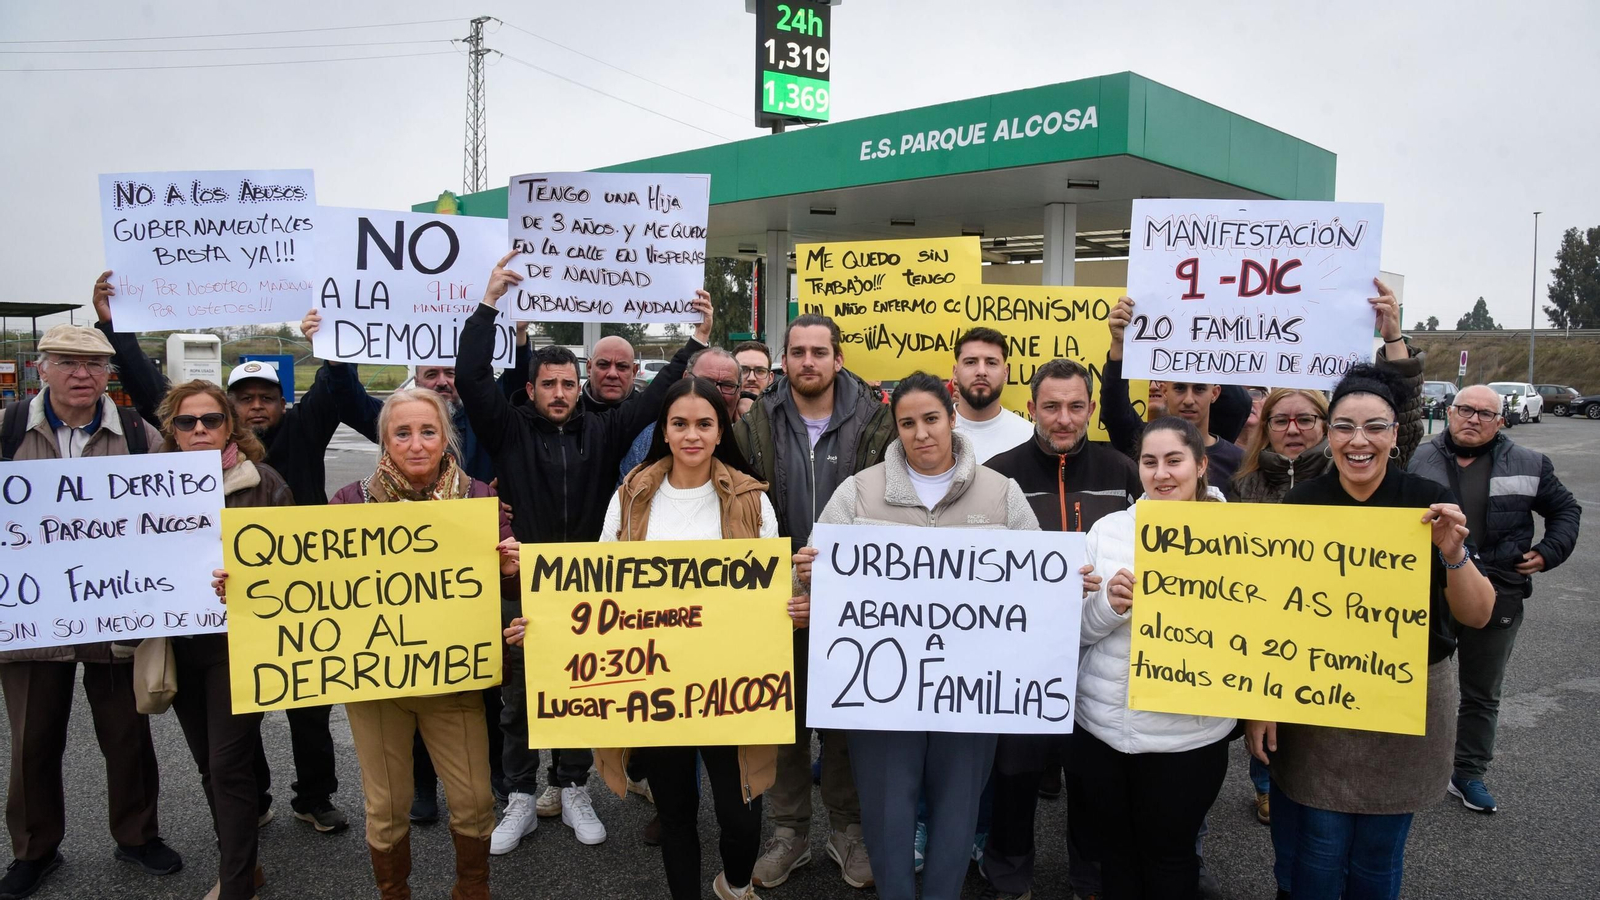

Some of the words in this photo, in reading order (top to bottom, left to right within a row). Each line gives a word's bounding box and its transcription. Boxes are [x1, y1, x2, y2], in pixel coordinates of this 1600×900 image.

[777, 4, 823, 38] 24h
[764, 38, 830, 73] 1,319
[764, 80, 829, 113] 1,369
[859, 138, 896, 161] E.S.
[900, 122, 987, 155] PARQUE
[992, 105, 1098, 142] ALCOSA
[114, 181, 155, 210] NO
[165, 183, 186, 206] A
[519, 178, 591, 204] TENGO
[604, 191, 640, 207] UNA
[522, 216, 543, 231] DE
[551, 213, 566, 232] 3
[1144, 215, 1367, 250] MANIFESTACIÓN
[153, 244, 231, 266] BASTA
[241, 239, 295, 269] YA!!!
[357, 217, 460, 274] NO
[513, 239, 535, 255] EN
[566, 245, 604, 261] CALLE
[615, 249, 638, 263] EN
[806, 246, 834, 272] ME
[842, 250, 901, 269] QUEDO
[152, 278, 181, 296] POR
[526, 264, 553, 279] DE
[562, 264, 651, 287] NAVIDAD
[805, 273, 886, 296] TRABAJO!!!
[902, 269, 956, 286] TENGO
[149, 303, 177, 317] POR
[321, 277, 341, 309] A
[355, 279, 390, 310] LA
[413, 303, 478, 313] MANIFESTAC
[517, 289, 613, 315] URBANISMO
[624, 299, 699, 319] AYUDANO
[873, 299, 937, 315] ENFERMO
[965, 296, 1110, 322] URBANISMO
[1132, 314, 1174, 342] 20
[1190, 314, 1305, 343] FAMILIAS
[1054, 335, 1079, 357] LA
[1152, 348, 1267, 374] DEPENDEN
[1276, 353, 1302, 374] DE
[2, 475, 32, 504] O
[56, 475, 93, 502] AL
[108, 470, 217, 500] DERRIBO
[41, 515, 129, 544] PARQUE
[138, 512, 212, 535] ALCOSA
[233, 524, 439, 567] QUEREMOS
[531, 550, 779, 593] MANIFESTACIÓN
[831, 542, 1068, 583] URBANISMO
[0, 572, 40, 608] 20
[246, 567, 483, 619] SOLUCIONES
[52, 618, 85, 639] SU
[96, 611, 155, 634] MEDIO
[163, 611, 188, 629] DE
[571, 601, 592, 635] 9
[838, 599, 1027, 633] ABANDONA
[1346, 592, 1428, 638] Parque
[277, 618, 341, 657] NO
[365, 614, 428, 650] AL
[926, 633, 945, 651] A
[1140, 611, 1214, 649] alcosa
[1261, 638, 1298, 661] 20
[253, 641, 493, 706] DERRUMBE
[564, 638, 671, 682] 10:30h
[1131, 650, 1212, 687] tiradas
[1222, 672, 1252, 693] en
[1263, 672, 1282, 699] la
[826, 636, 908, 709] 20
[917, 657, 1070, 722] FAMILIAS
